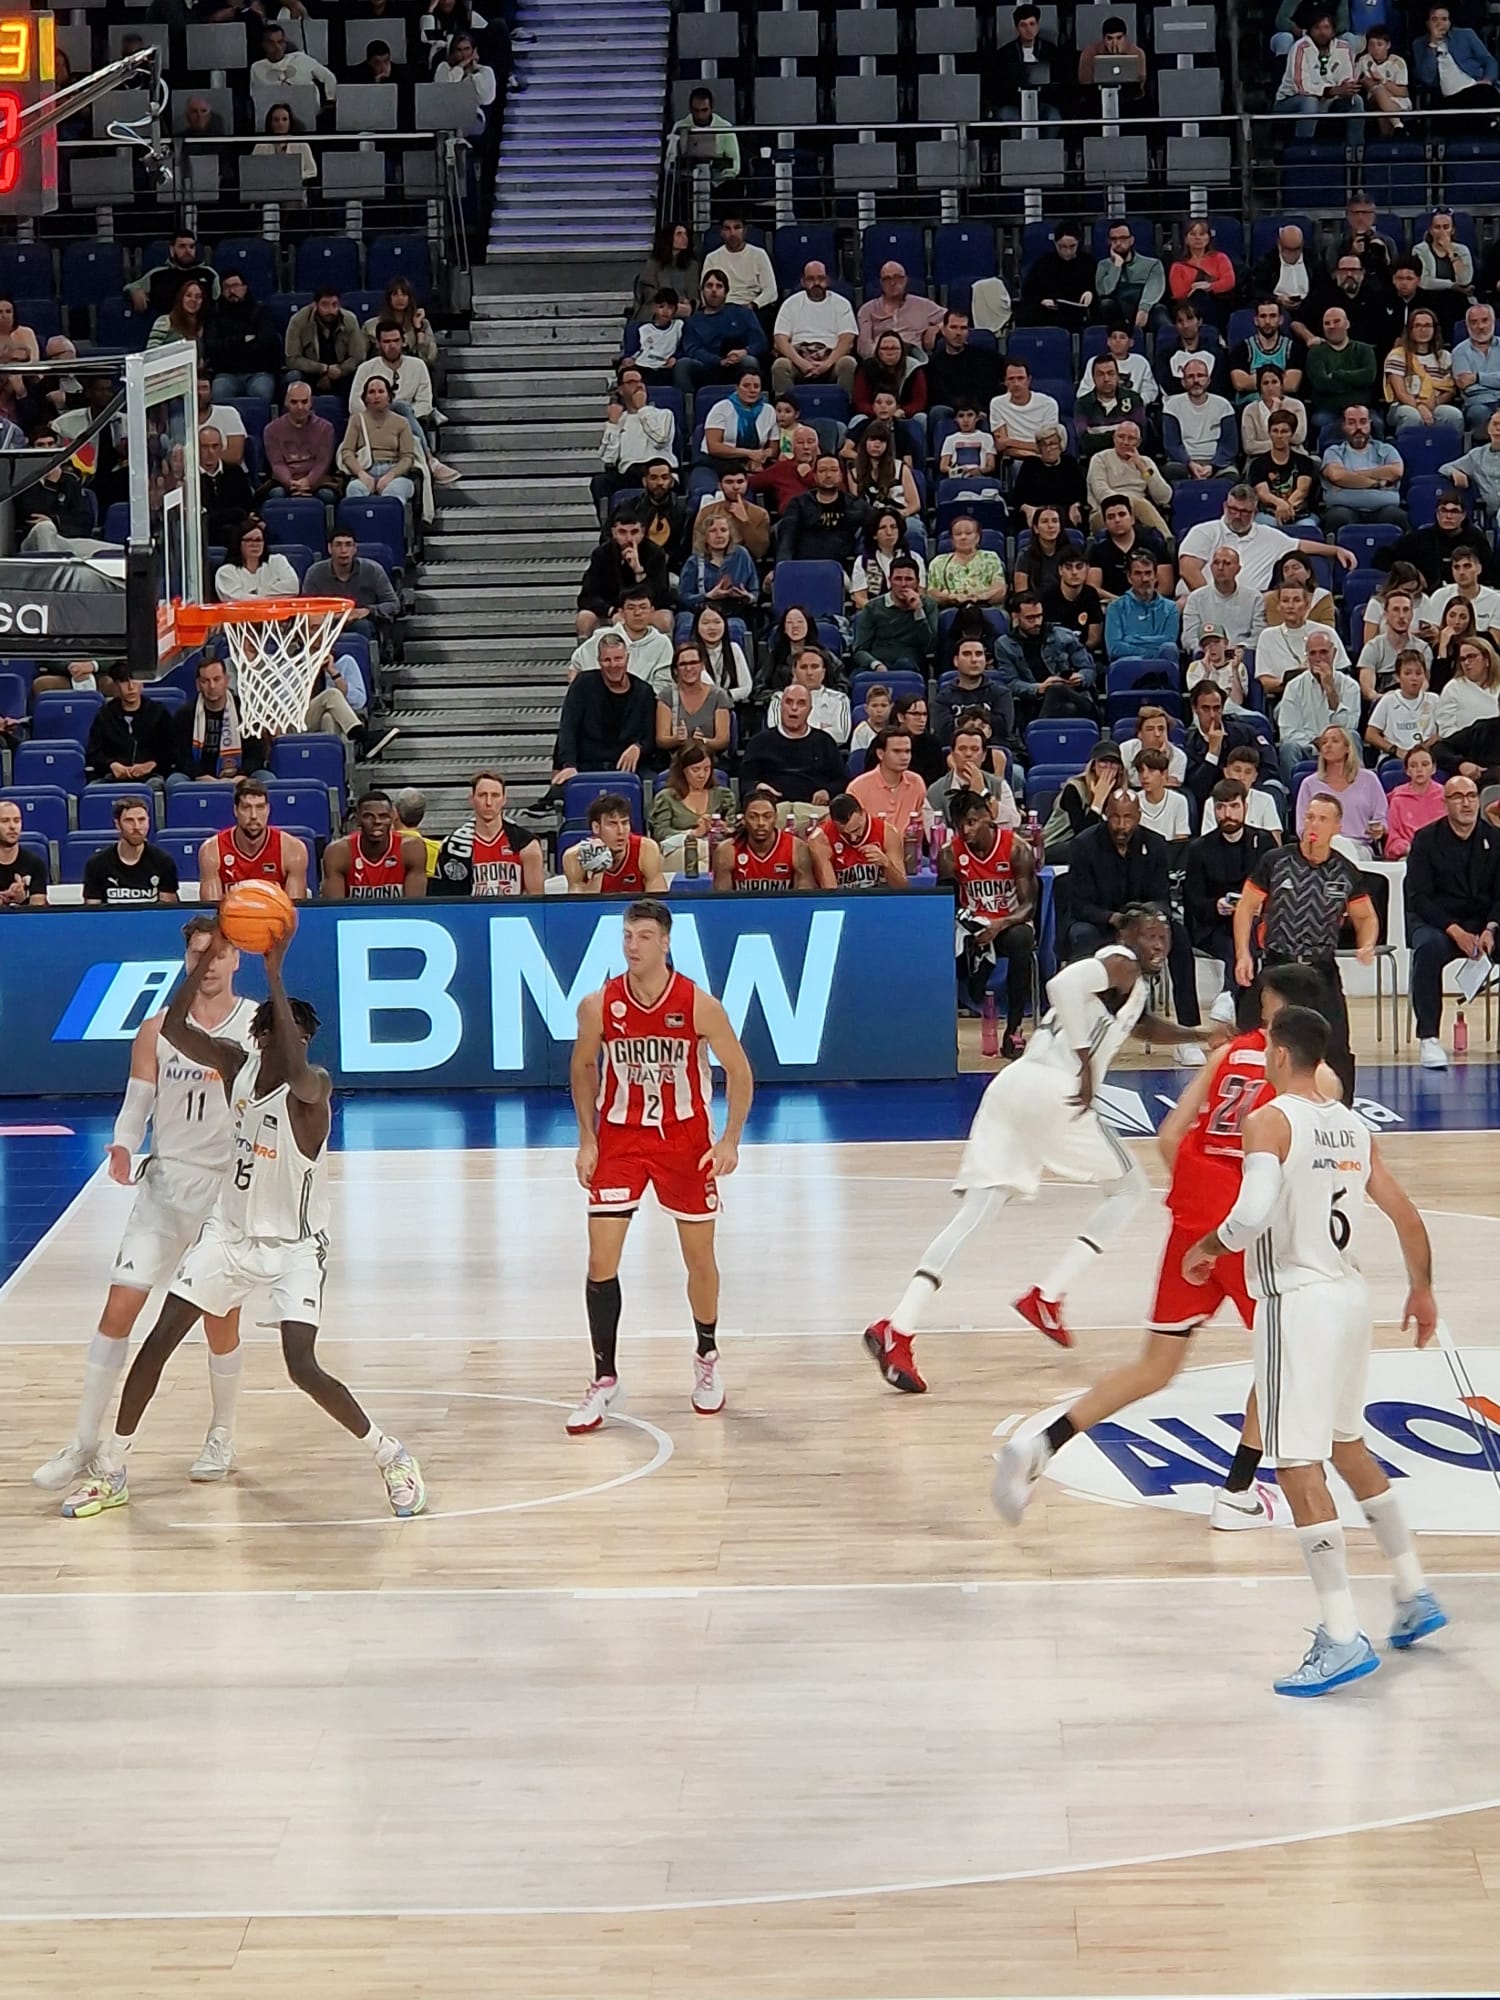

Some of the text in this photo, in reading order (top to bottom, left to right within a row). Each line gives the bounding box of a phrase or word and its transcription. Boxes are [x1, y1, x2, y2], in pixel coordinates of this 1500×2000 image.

[1121, 397, 1132, 413] 8
[336, 910, 846, 1072] BMW
[614, 1038, 684, 1065] GIRONA
[186, 1090, 206, 1122] 11
[646, 1094, 660, 1120] 2
[1329, 1187, 1351, 1252] 6
